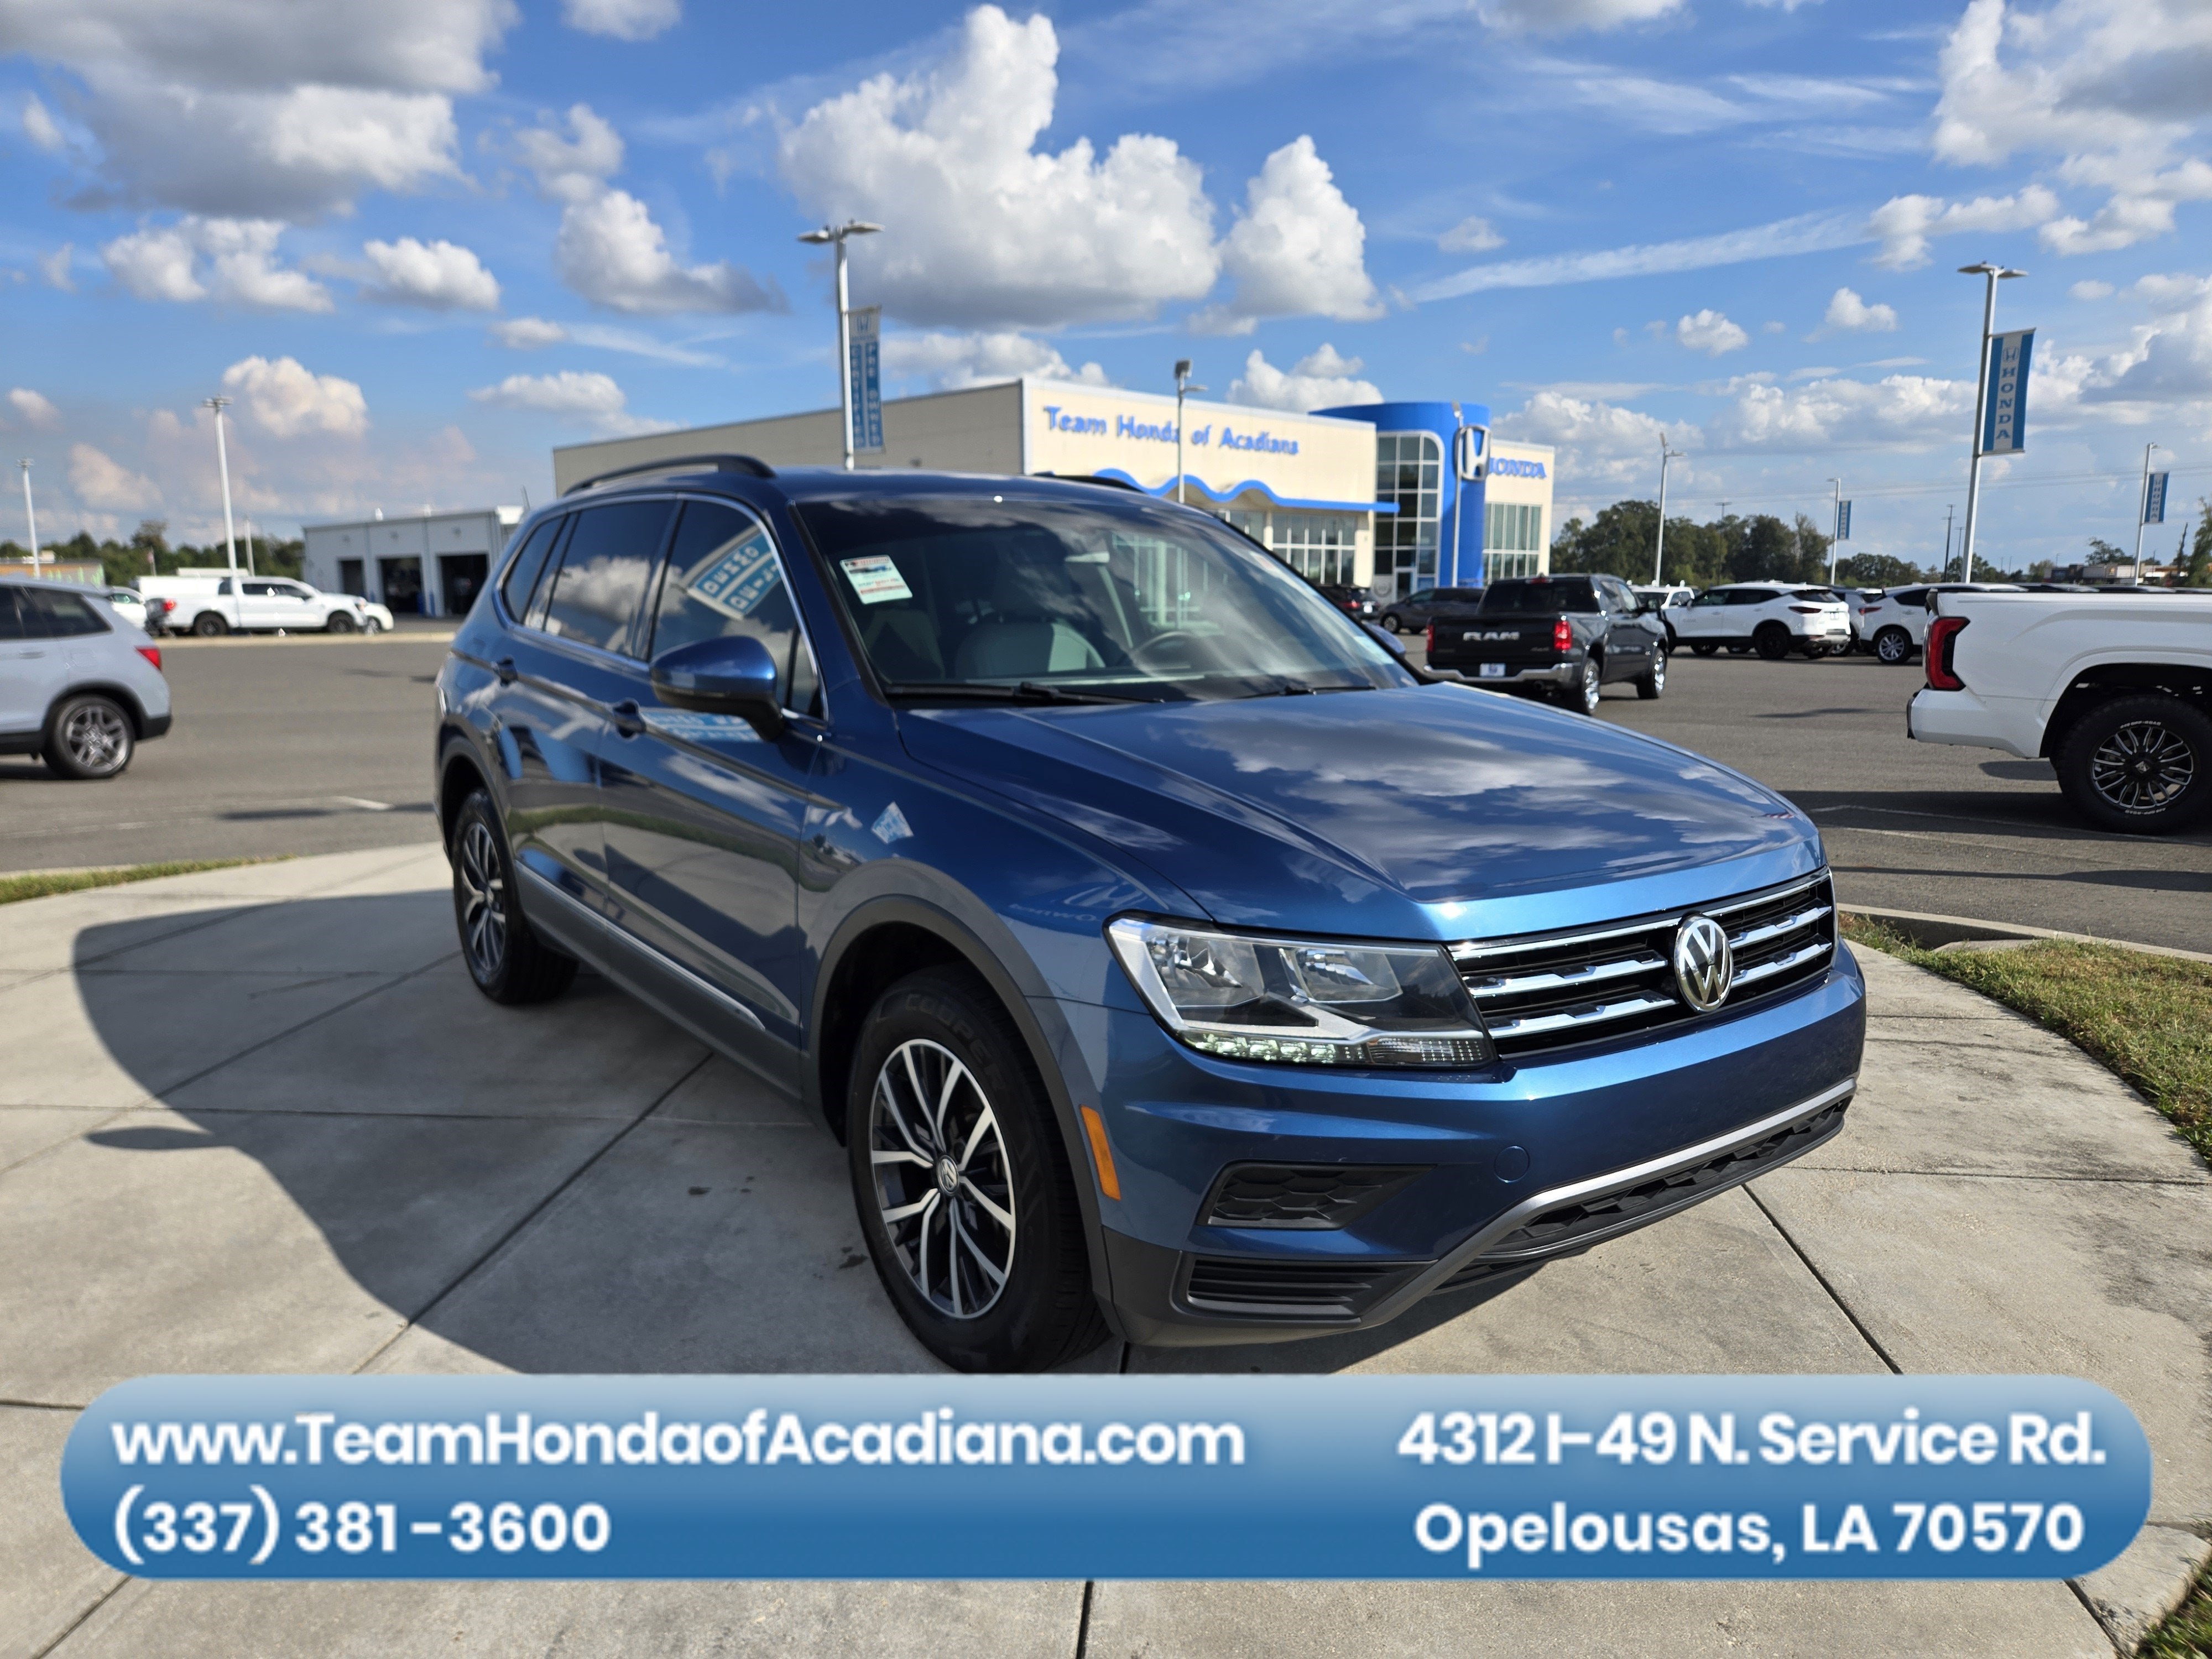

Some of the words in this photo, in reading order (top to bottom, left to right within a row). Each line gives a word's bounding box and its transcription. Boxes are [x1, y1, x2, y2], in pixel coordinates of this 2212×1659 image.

[1996, 367, 2016, 440] HONDA
[1044, 405, 1107, 434] Team
[1191, 424, 1212, 445] of
[1219, 427, 1298, 455] Acadiana
[1463, 632, 1520, 641] RAM
